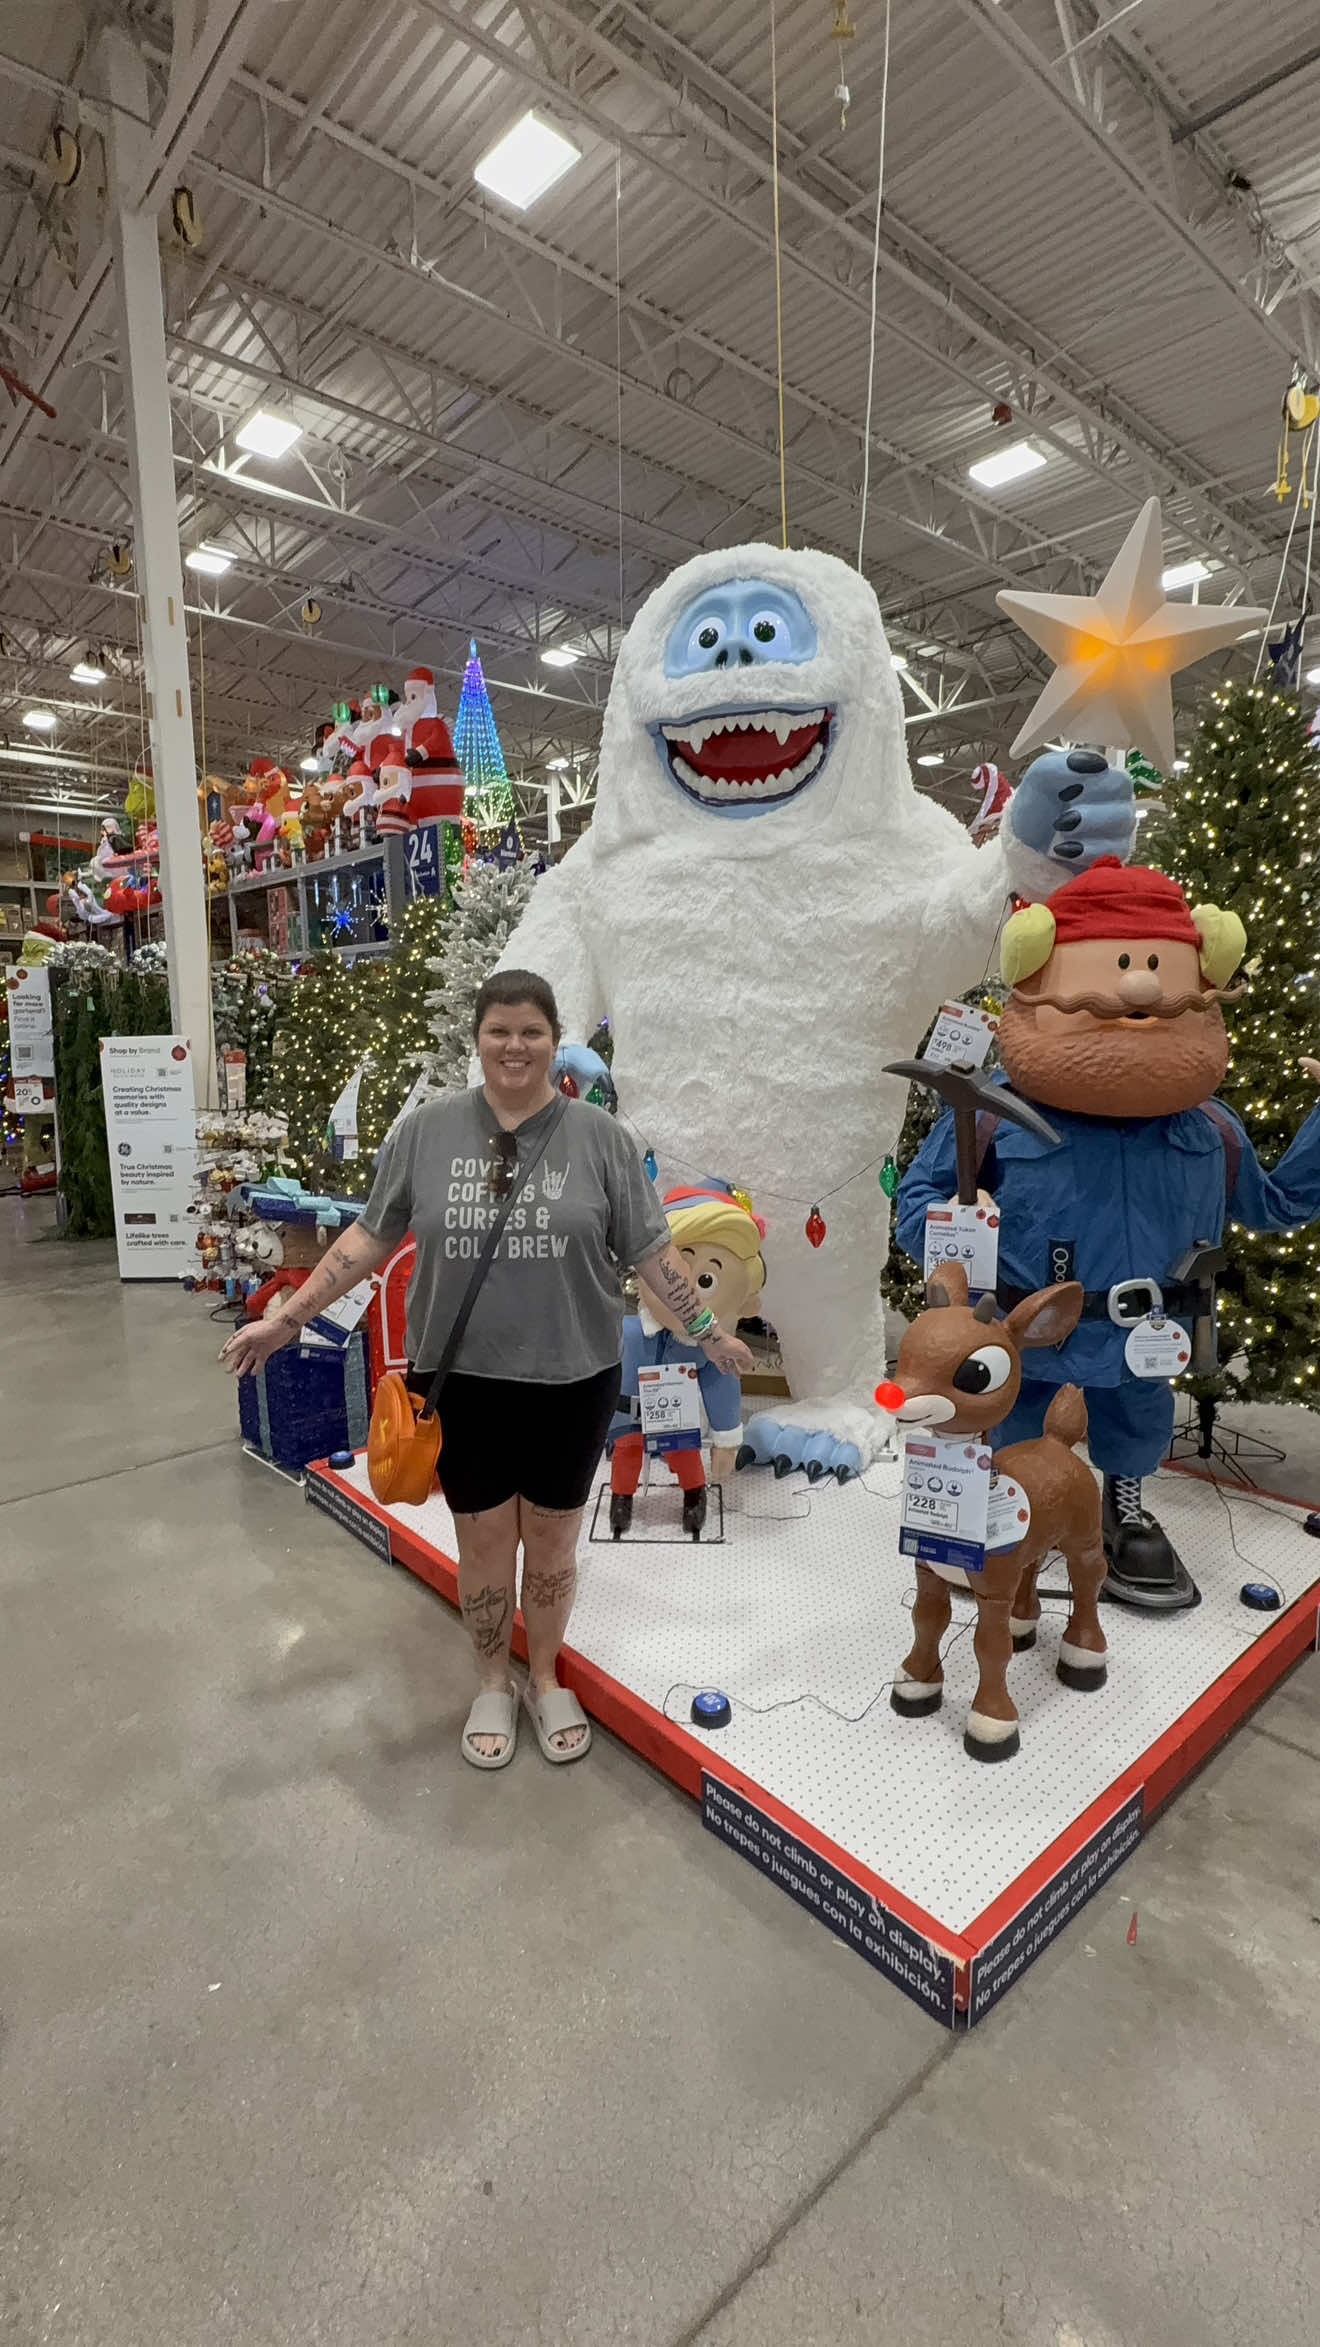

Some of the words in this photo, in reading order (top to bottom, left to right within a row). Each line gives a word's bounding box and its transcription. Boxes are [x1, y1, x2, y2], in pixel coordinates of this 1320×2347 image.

[408, 830, 433, 867] 24
[451, 1158, 533, 1180] COV
[448, 1182, 535, 1203] COFS
[536, 1206, 550, 1230] &
[508, 1234, 569, 1259] BREW
[909, 1459, 941, 1470] Animated
[706, 1783, 742, 1818] Please
[744, 1813, 759, 1832] do
[762, 1827, 781, 1850] not
[784, 1845, 818, 1878] climb
[820, 1874, 834, 1889] or
[836, 1886, 866, 1919] play
[868, 1911, 885, 1935] on
[889, 1928, 946, 1983] display.
[977, 1943, 1011, 1984] Please
[1012, 1927, 1025, 1946] do
[1027, 1908, 1043, 1931] not
[1044, 1882, 1069, 1912] climb
[1070, 1869, 1080, 1882] or
[1080, 1850, 1099, 1877] play
[1100, 1837, 1111, 1853] on
[1112, 1808, 1142, 1843] display.
[706, 1805, 722, 1826] No
[724, 1817, 761, 1858] trepes
[762, 1851, 770, 1864] o
[771, 1856, 820, 1906] juegues
[823, 1900, 847, 1929] con
[849, 1918, 862, 1940] la
[865, 1935, 947, 2010] exhibición.
[975, 1988, 990, 2011] No
[993, 1953, 1025, 1989] trepes
[1026, 1943, 1033, 1954] o
[1033, 1904, 1070, 1954] juegues
[1071, 1889, 1087, 1907] con
[1088, 1873, 1097, 1889] la
